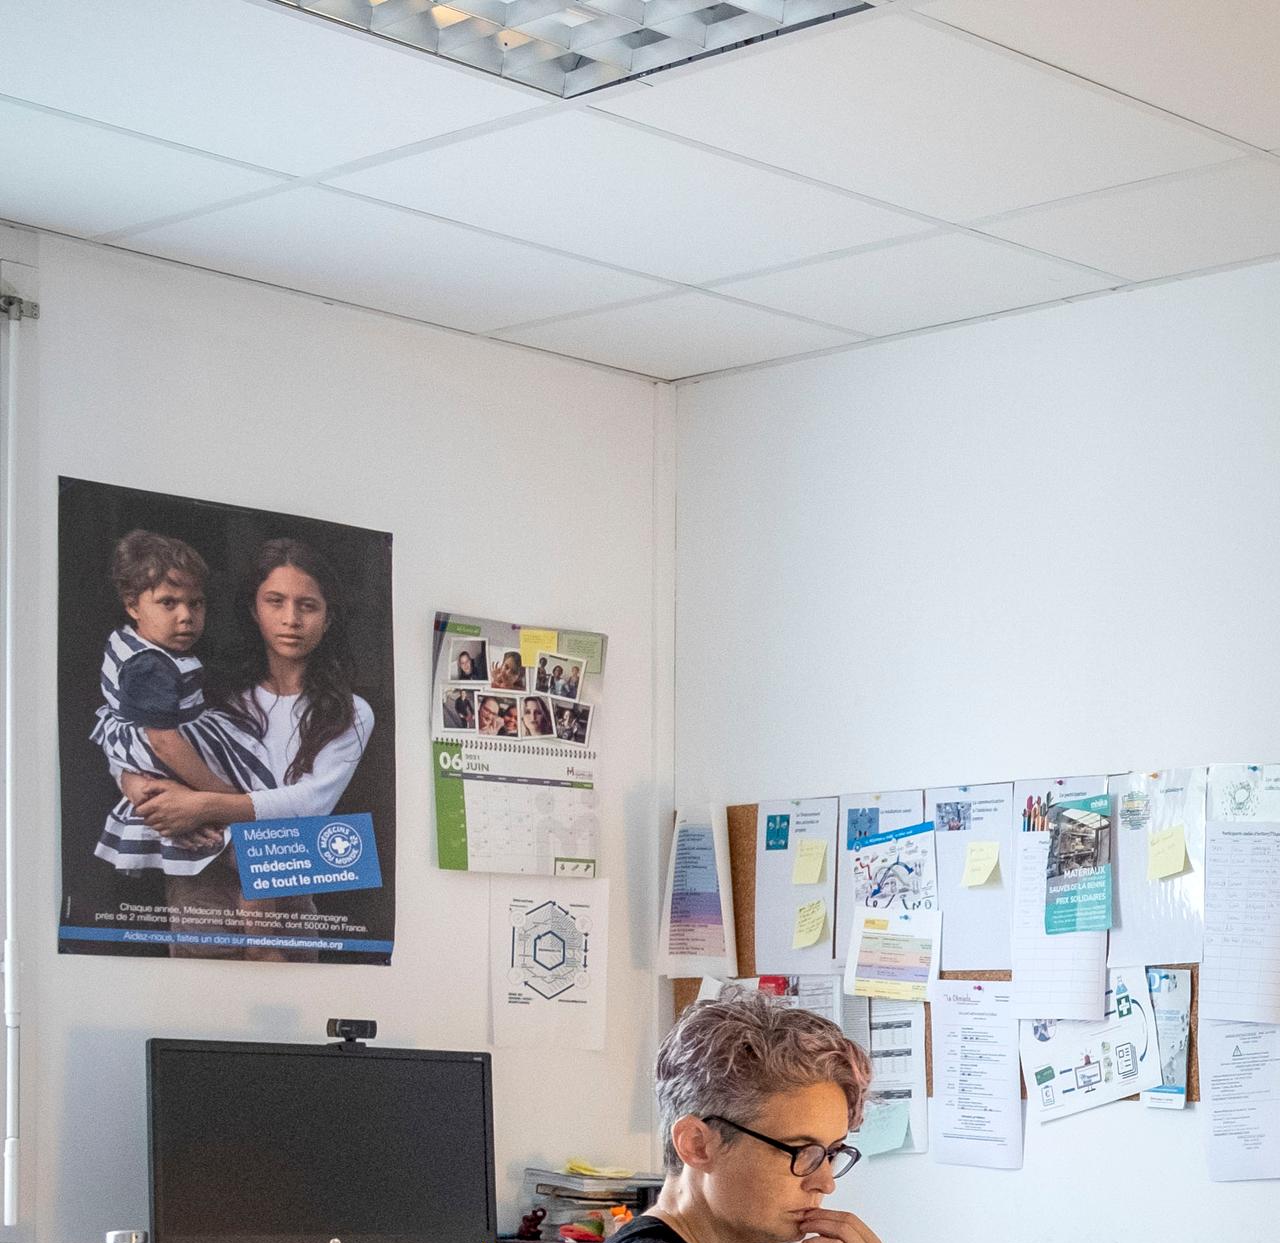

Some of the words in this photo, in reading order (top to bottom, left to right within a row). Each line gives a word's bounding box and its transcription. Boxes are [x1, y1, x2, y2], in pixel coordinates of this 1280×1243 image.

[439, 752, 463, 770] 06
[465, 761, 490, 773] JUIN
[243, 826, 300, 841] Médecins
[247, 846, 264, 858] du
[250, 858, 312, 873] médecins
[253, 877, 270, 890] de
[272, 875, 297, 888] tout
[299, 874, 311, 885] le
[313, 870, 359, 885] monde.
[213, 935, 230, 945] don
[246, 937, 344, 950] medecinsdumonde.org
